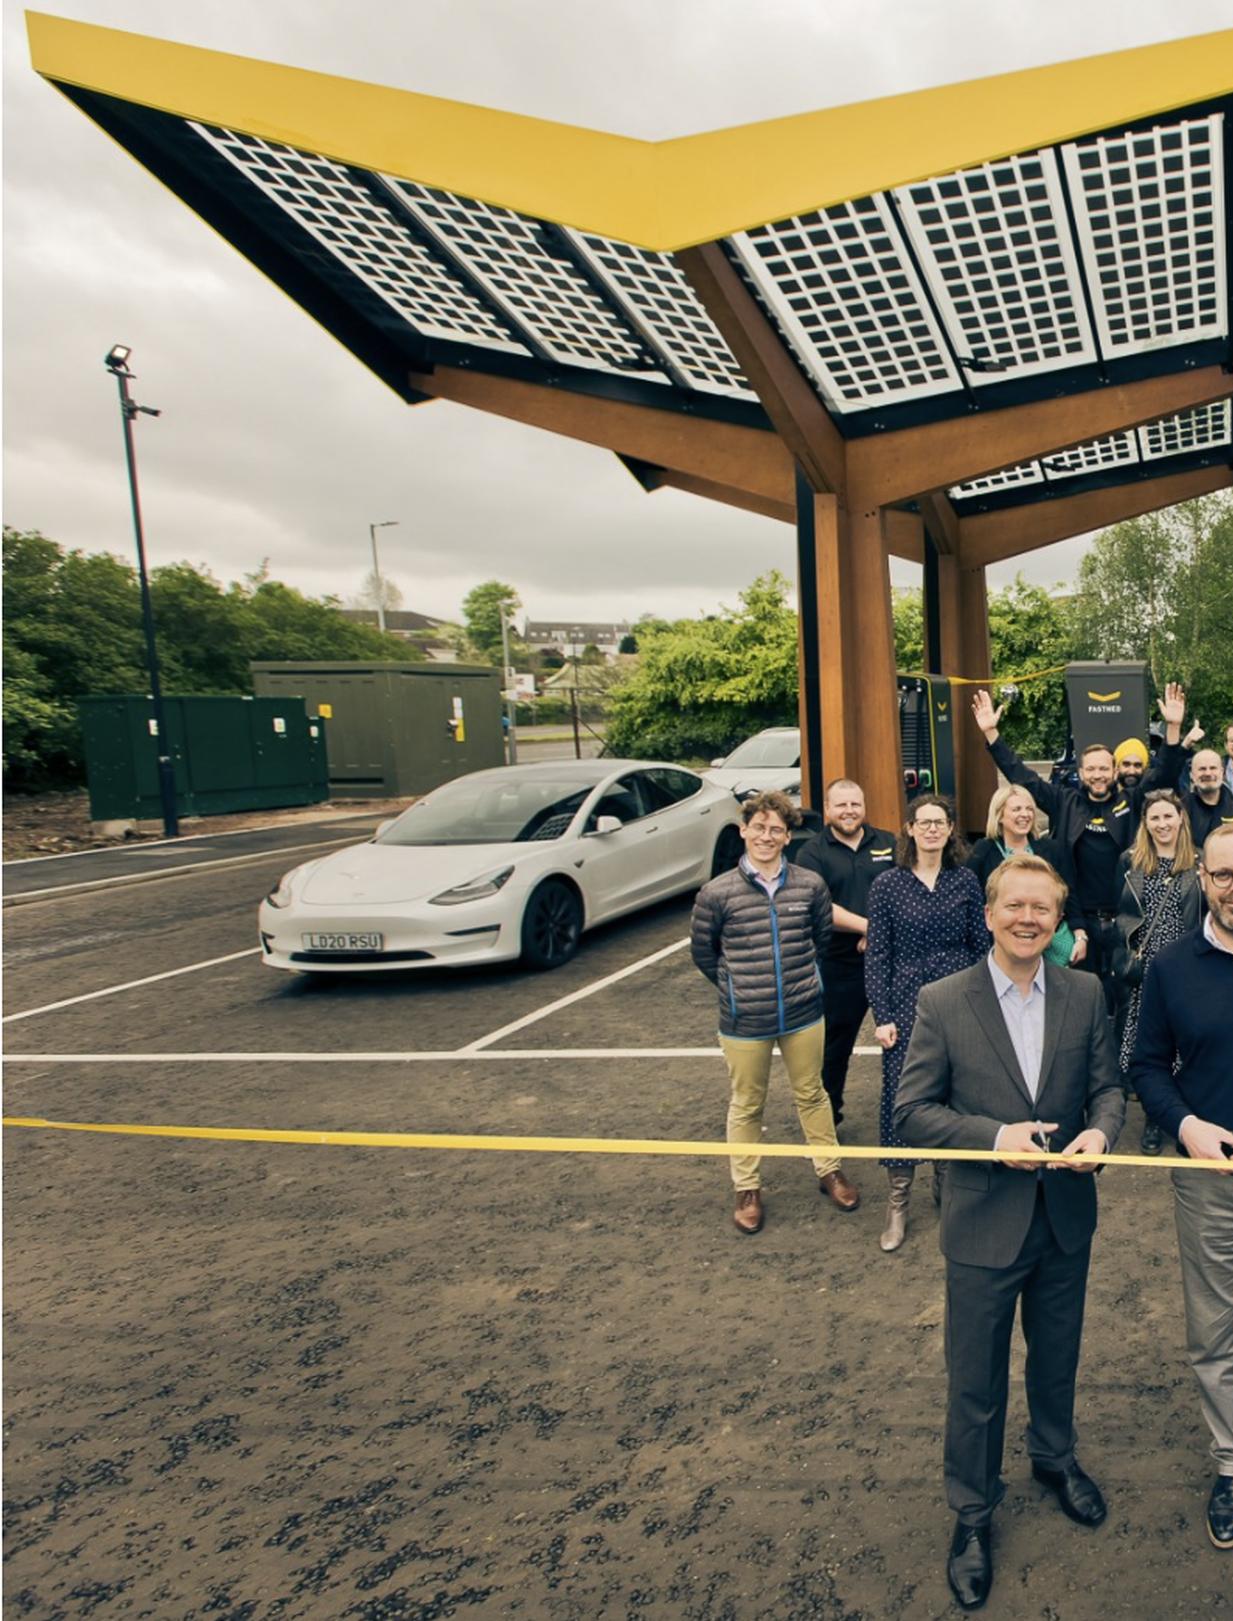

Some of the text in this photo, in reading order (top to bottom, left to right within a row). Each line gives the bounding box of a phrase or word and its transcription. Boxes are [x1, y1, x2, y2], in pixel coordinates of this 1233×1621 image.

[1088, 705, 1121, 713] FASTNED
[310, 935, 378, 948] LD20 RSU
